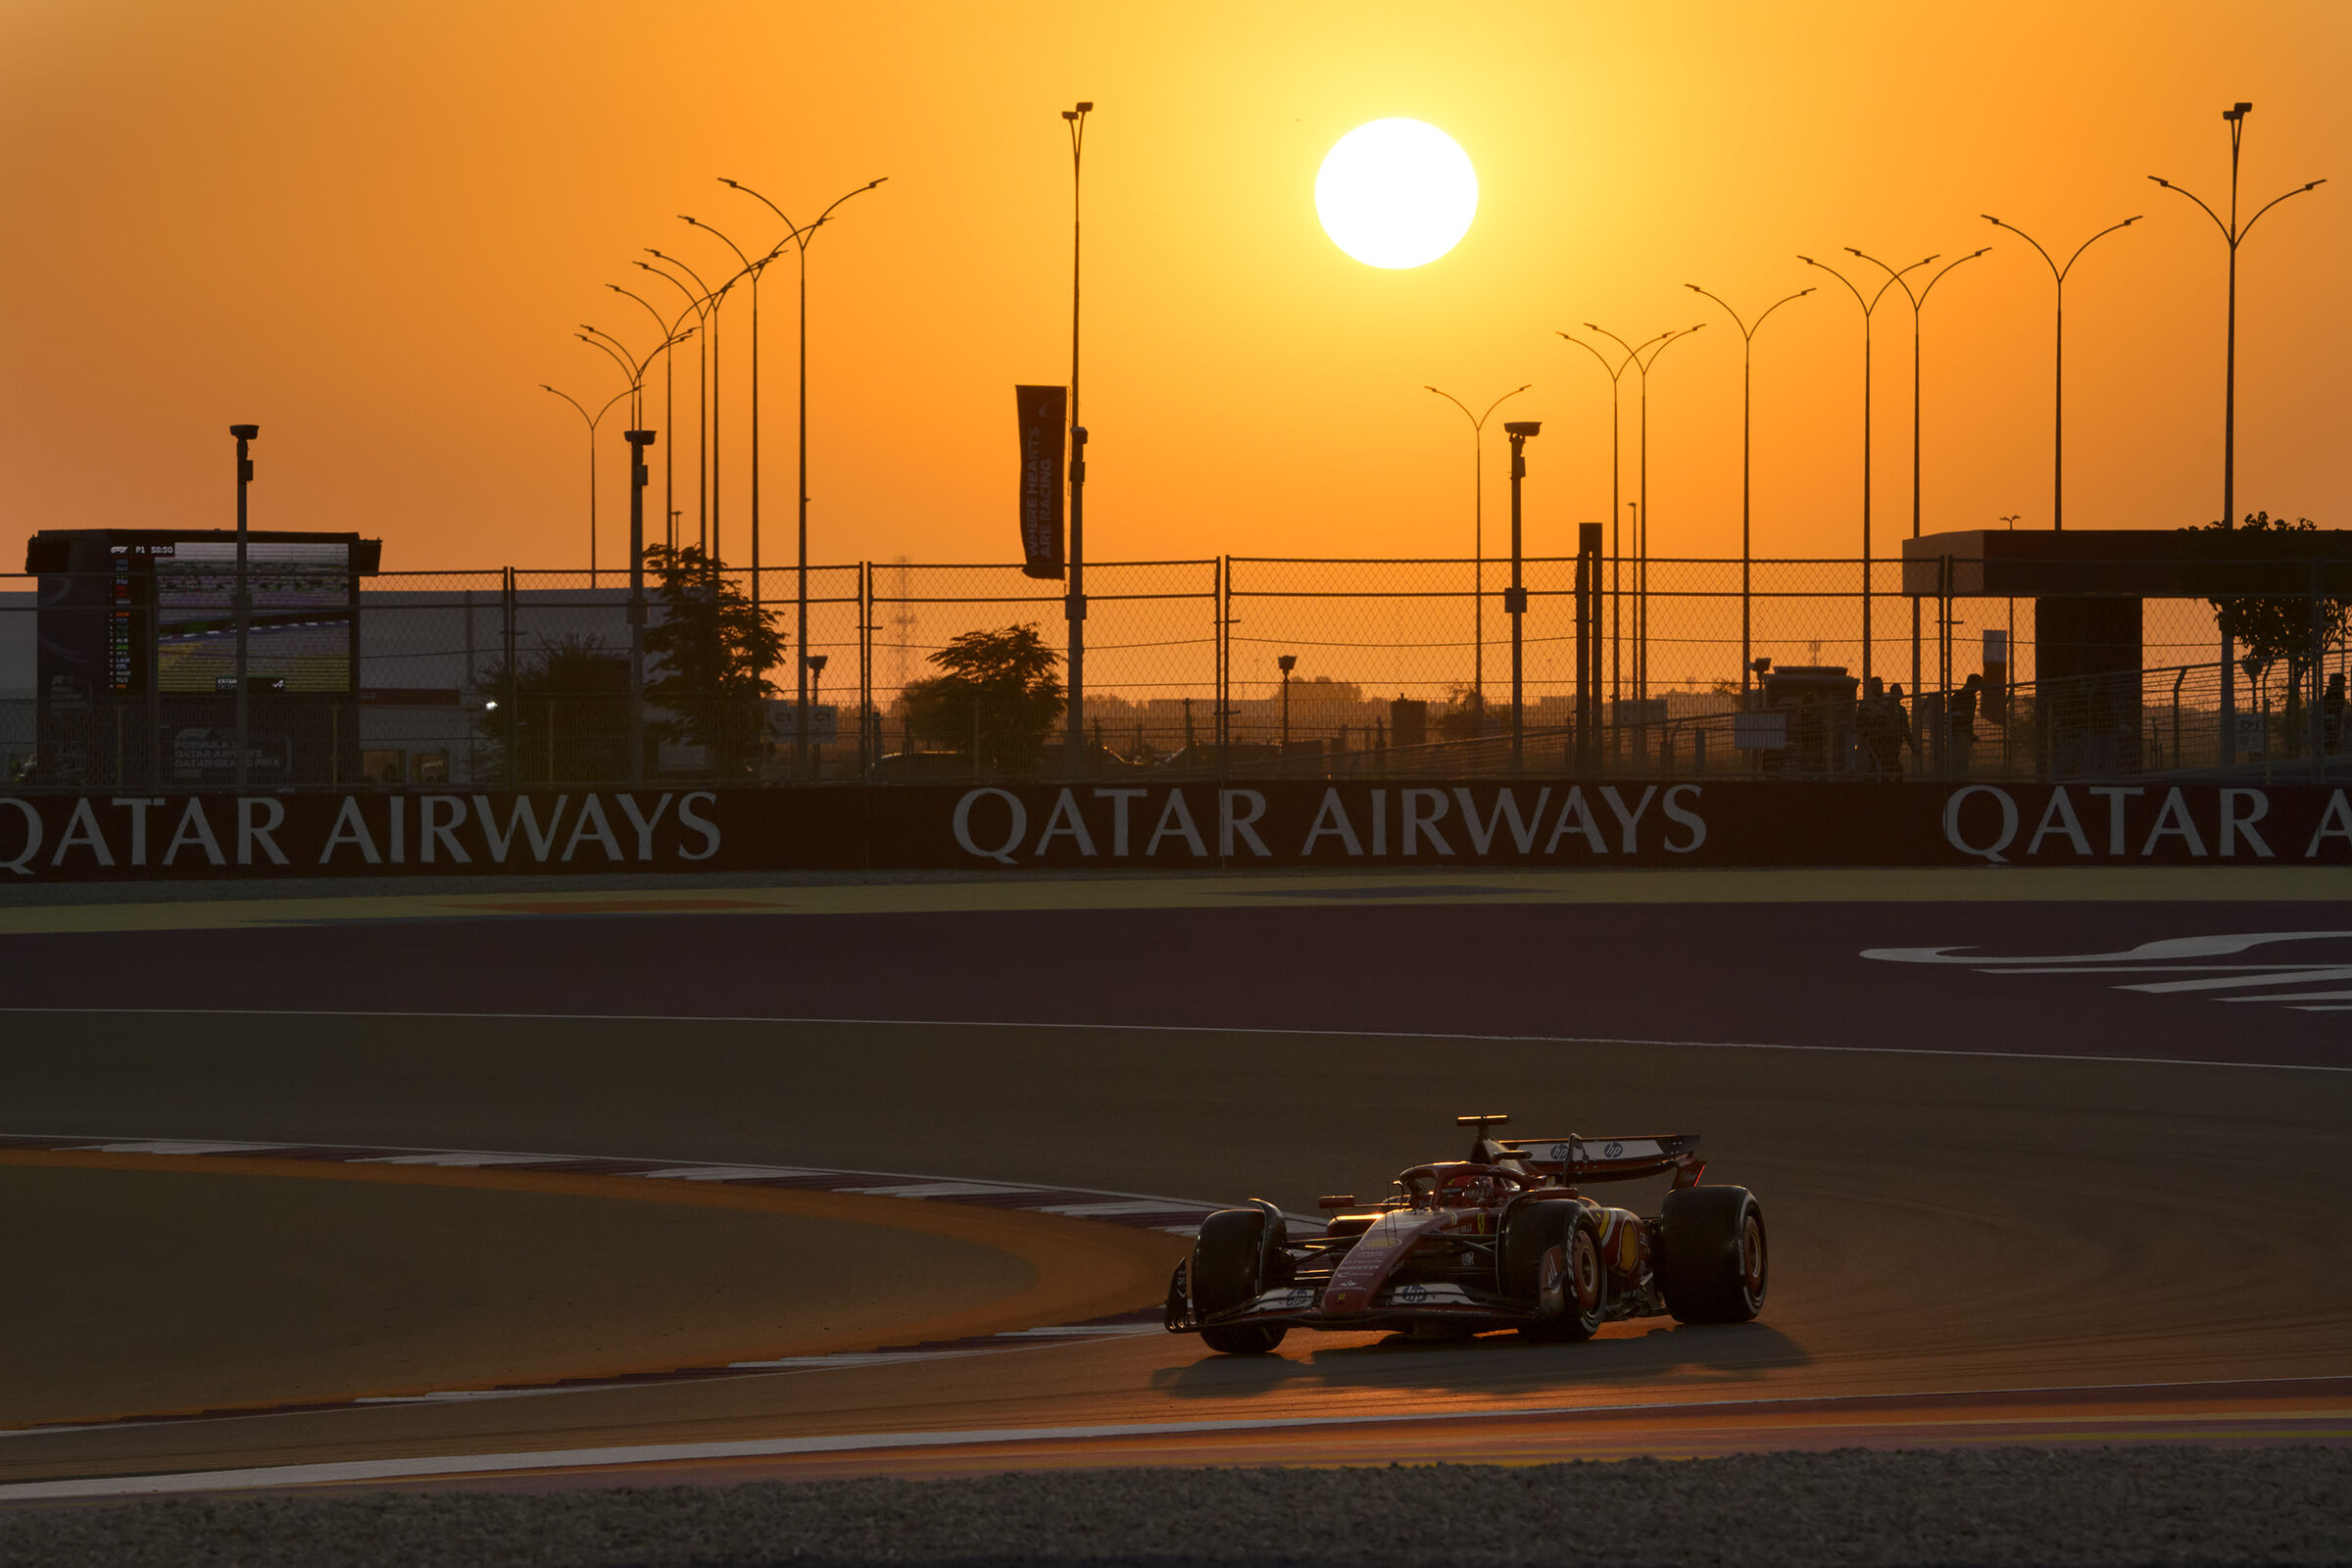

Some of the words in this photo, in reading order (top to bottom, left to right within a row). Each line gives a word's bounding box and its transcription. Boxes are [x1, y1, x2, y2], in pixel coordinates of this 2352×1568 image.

[1027, 427, 1040, 495] HEARTS
[1041, 459, 1052, 520] RACING
[1026, 497, 1038, 557] WHERE
[1040, 524, 1052, 558] ARE
[0, 796, 291, 875] QATAR
[318, 790, 722, 864] AIRWAYS
[953, 787, 1273, 865] QATAR
[1300, 783, 1708, 858] AIRWAYS
[1941, 784, 2277, 863] QATAR
[1604, 1143, 1623, 1158] hp
[1401, 1285, 1427, 1301] hp
